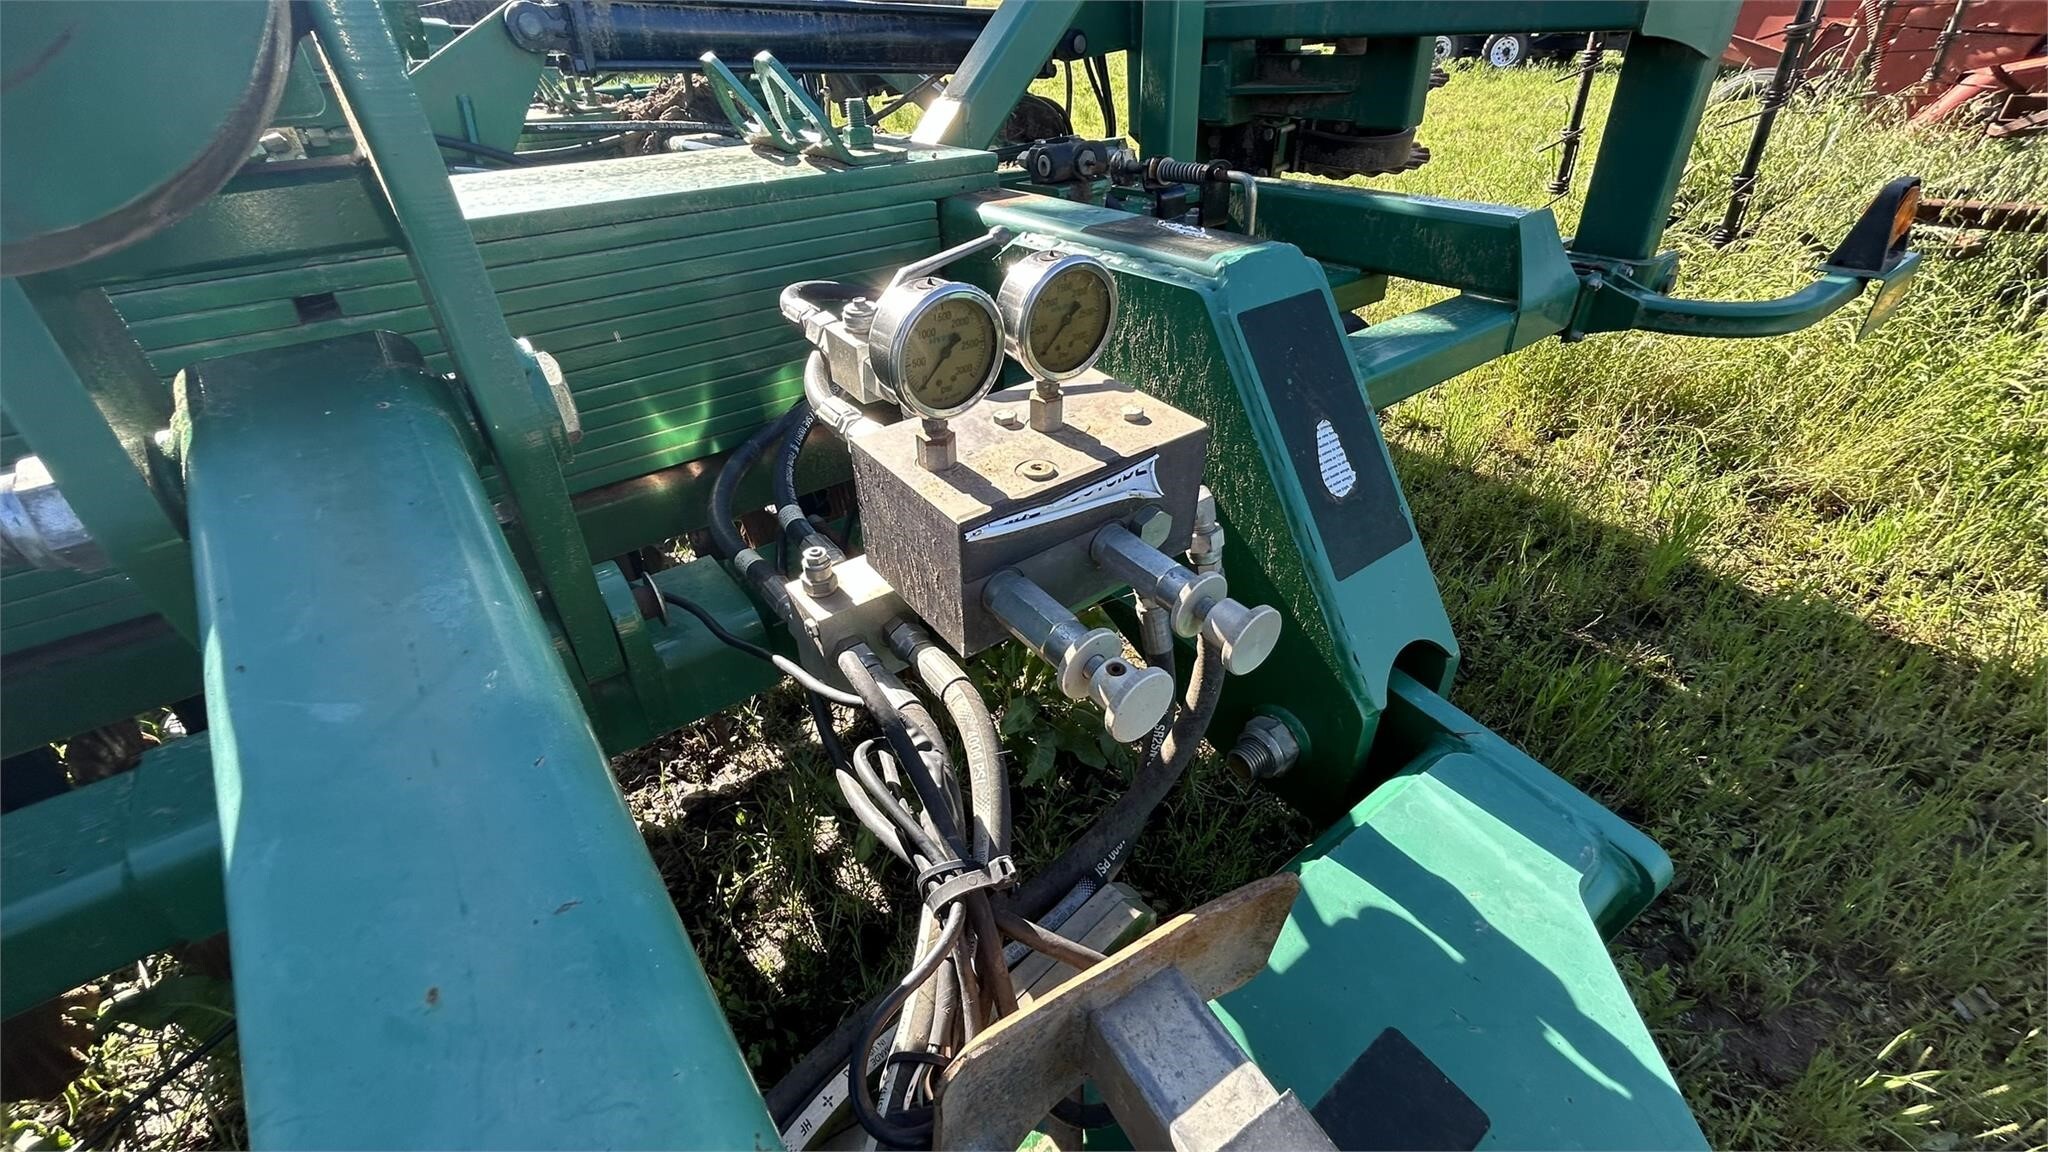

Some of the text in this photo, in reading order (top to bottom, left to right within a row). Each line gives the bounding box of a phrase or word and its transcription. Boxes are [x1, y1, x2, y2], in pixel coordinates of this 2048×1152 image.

[933, 310, 952, 321] 1500
[951, 316, 970, 328] 2000
[917, 327, 937, 340] 1000
[961, 338, 981, 351] 2500
[912, 356, 927, 368] 500
[966, 731, 986, 784] 4000 PSI
[1094, 860, 1112, 878] PSI
[800, 1118, 813, 1137] HF
